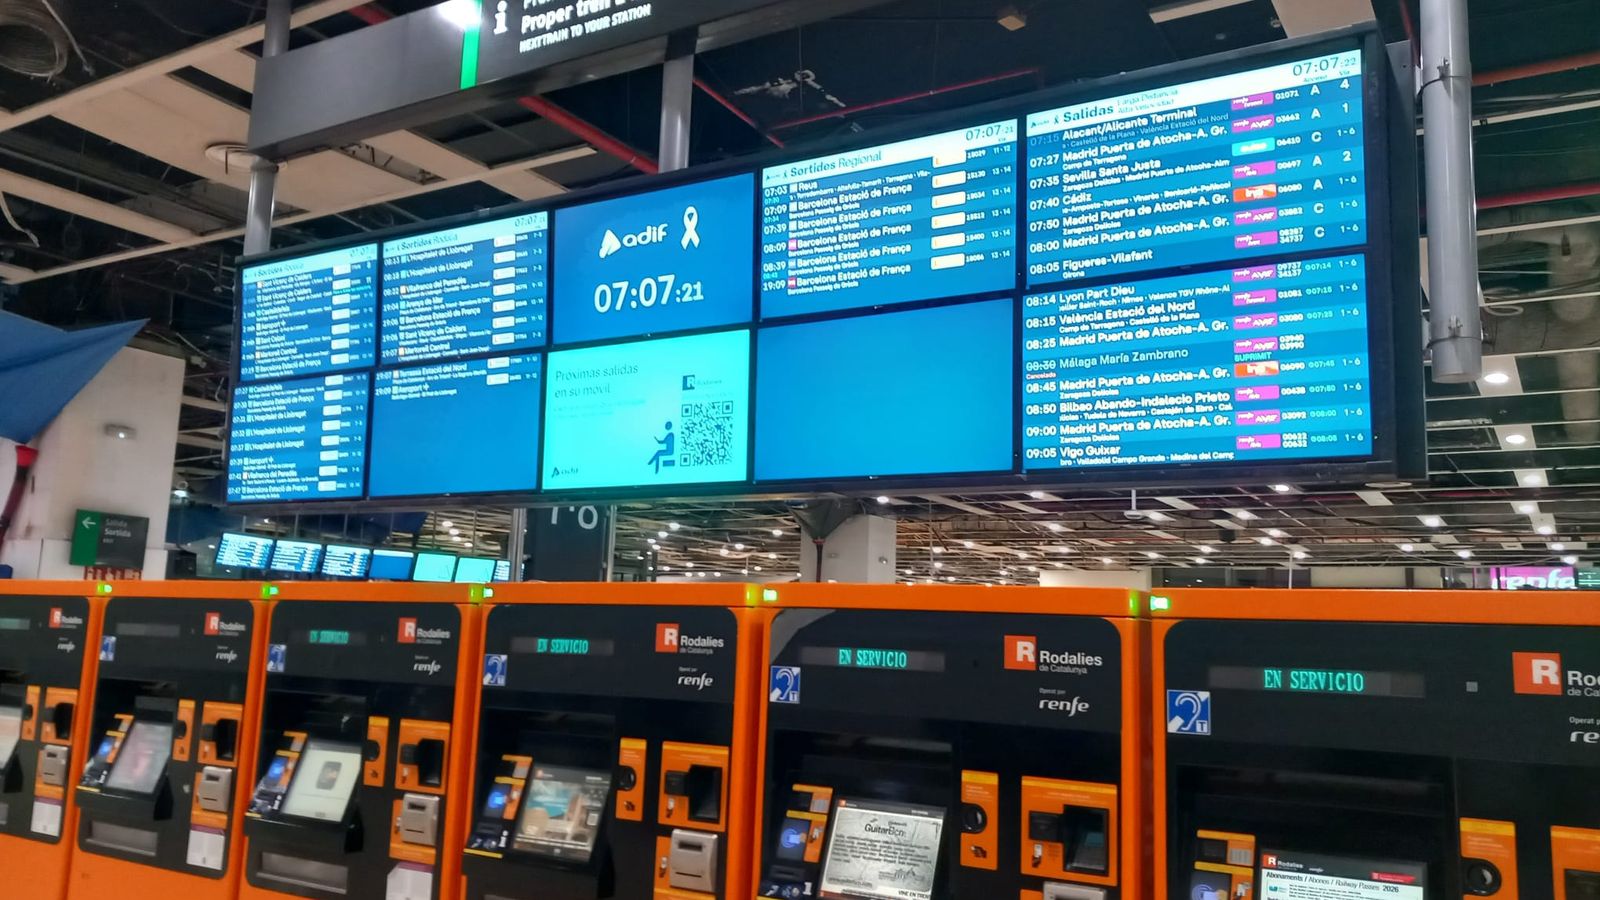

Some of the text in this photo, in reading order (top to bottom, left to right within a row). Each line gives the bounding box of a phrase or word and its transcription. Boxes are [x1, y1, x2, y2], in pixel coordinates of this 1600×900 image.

[521, 5, 574, 34] Proper
[570, 24, 582, 38] TO
[584, 17, 610, 33] YOUR
[611, 4, 652, 26] STATION
[1310, 84, 1319, 95] A
[1339, 78, 1349, 90] 4
[1063, 102, 1113, 122] Salidas
[1063, 115, 1148, 142] Alacant/Alicante
[1151, 107, 1196, 124] Terminal
[1030, 123, 1227, 168] 07:27 Madrid Puerta de Atocha-A. Gr.
[1311, 131, 1321, 142] C
[791, 150, 881, 177] Sortides Regional
[1063, 153, 1126, 171] Camp de Tarragona
[1312, 154, 1322, 166] A
[1343, 150, 1351, 161] 2
[1030, 158, 1160, 189] 07:35 Sevilla Santa Justa
[764, 180, 817, 197] 07:03 Reus
[764, 182, 911, 215] 07:09 Barcelona Estació de França
[1030, 191, 1091, 210] 07:40 Cádiz
[1030, 192, 1229, 231] 07:50 Madrid Puerta de Atocha-A. Gr.
[622, 224, 668, 247] adif
[764, 223, 911, 253] 08:09 Barcelona Estació de França
[1063, 224, 1093, 236] Zaragoza
[1030, 249, 1152, 275] 08:05 Figueres-Vilafant
[763, 263, 910, 290] 19:09 Barcelona Estació de França
[1063, 270, 1084, 279] Girona
[594, 274, 704, 312] 07:07:21
[1026, 284, 1134, 306] 08:14 Lyon Part Dieu
[1026, 300, 1195, 328] 08:15 València Estació del Nord
[1026, 320, 1228, 350] 08:25 Madrid Puerta de Atocha-A. Gr.
[1059, 355, 1097, 370] Málaga
[1100, 352, 1129, 365] María
[1131, 347, 1188, 362] Zambrano
[603, 364, 638, 378] salidas
[554, 388, 566, 398] en
[570, 387, 580, 396] su
[1026, 391, 1229, 415] 08:50 Bilbao Abando-Indalecio Prieto
[1026, 414, 1230, 436] 09:00 Madrid Puerta de Atocha-A. Gr.
[1026, 444, 1120, 458] 09:05 Vigo Guixar
[405, 622, 416, 637] R
[417, 628, 450, 639] Rodalies
[664, 628, 678, 645] R
[537, 638, 588, 654] EN SERVICIO
[680, 635, 724, 648] Rodalies
[1016, 641, 1035, 662] R
[216, 650, 238, 663] renfe
[839, 649, 907, 668] EN SERVICIO
[1040, 650, 1102, 666] Rodalies
[414, 660, 440, 676] renfe
[1050, 664, 1088, 675] Catalunya
[1532, 660, 1560, 684] R
[678, 672, 713, 690] renfe
[1264, 670, 1364, 692] EN SERVICIO
[1568, 688, 1582, 696] de
[1039, 696, 1090, 717] renfe
[1569, 716, 1595, 725] Operat
[1266, 872, 1304, 882] Abonaments
[1308, 876, 1330, 886] Abonos
[1336, 878, 1358, 890] Railway
[1358, 881, 1380, 891] Passes
[1382, 884, 1400, 894] 2026
